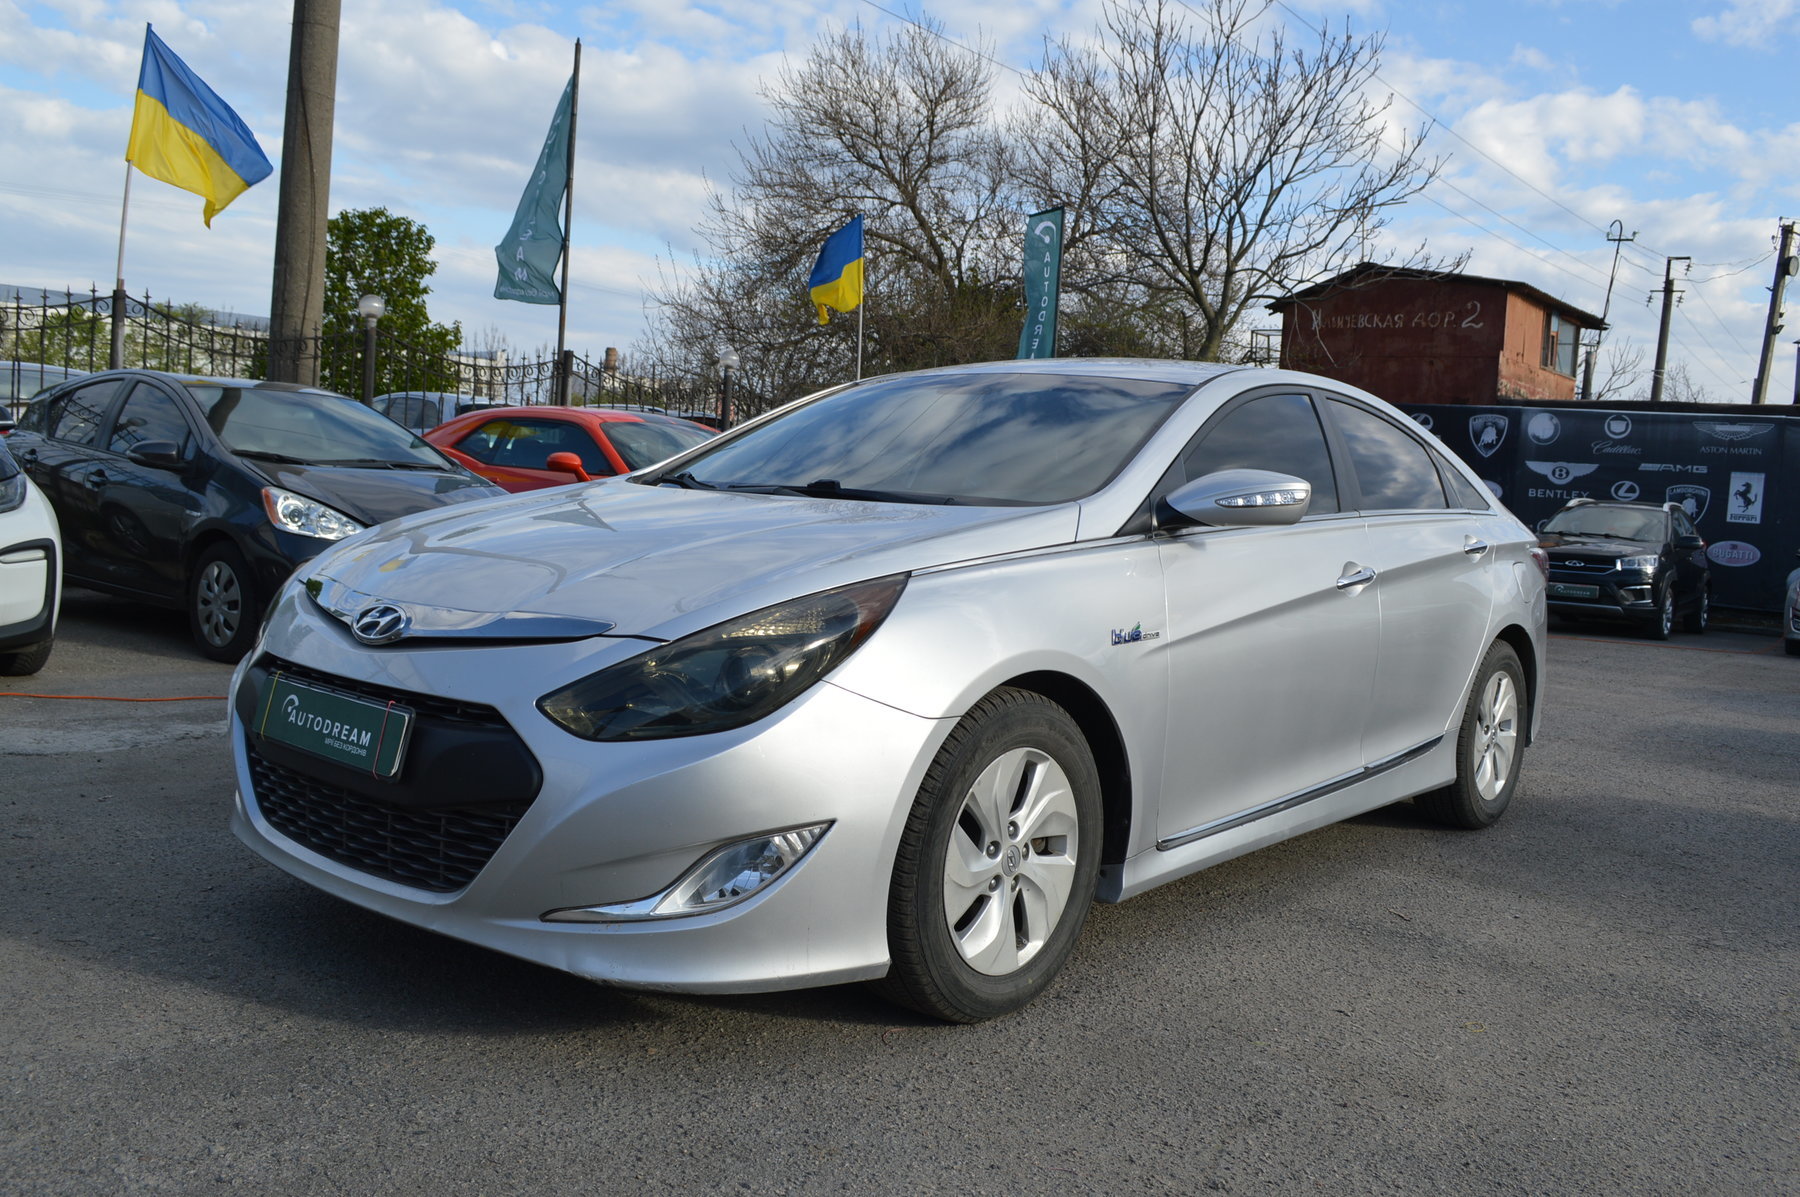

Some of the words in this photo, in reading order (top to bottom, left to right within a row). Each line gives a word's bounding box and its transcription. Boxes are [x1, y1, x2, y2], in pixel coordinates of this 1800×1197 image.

[1461, 301, 1484, 328] 2
[1701, 446, 1728, 455] ASTON
[1730, 447, 1762, 456] MARTIN
[1660, 463, 1708, 474] AMG
[1528, 488, 1590, 500] BENTLEY
[1730, 513, 1757, 522] Ferrari
[1712, 547, 1753, 560] BUGATTI
[288, 708, 372, 747] AUTODREAM
[333, 740, 343, 749] БЕЗ
[343, 743, 367, 757] КОРДОНІВ
